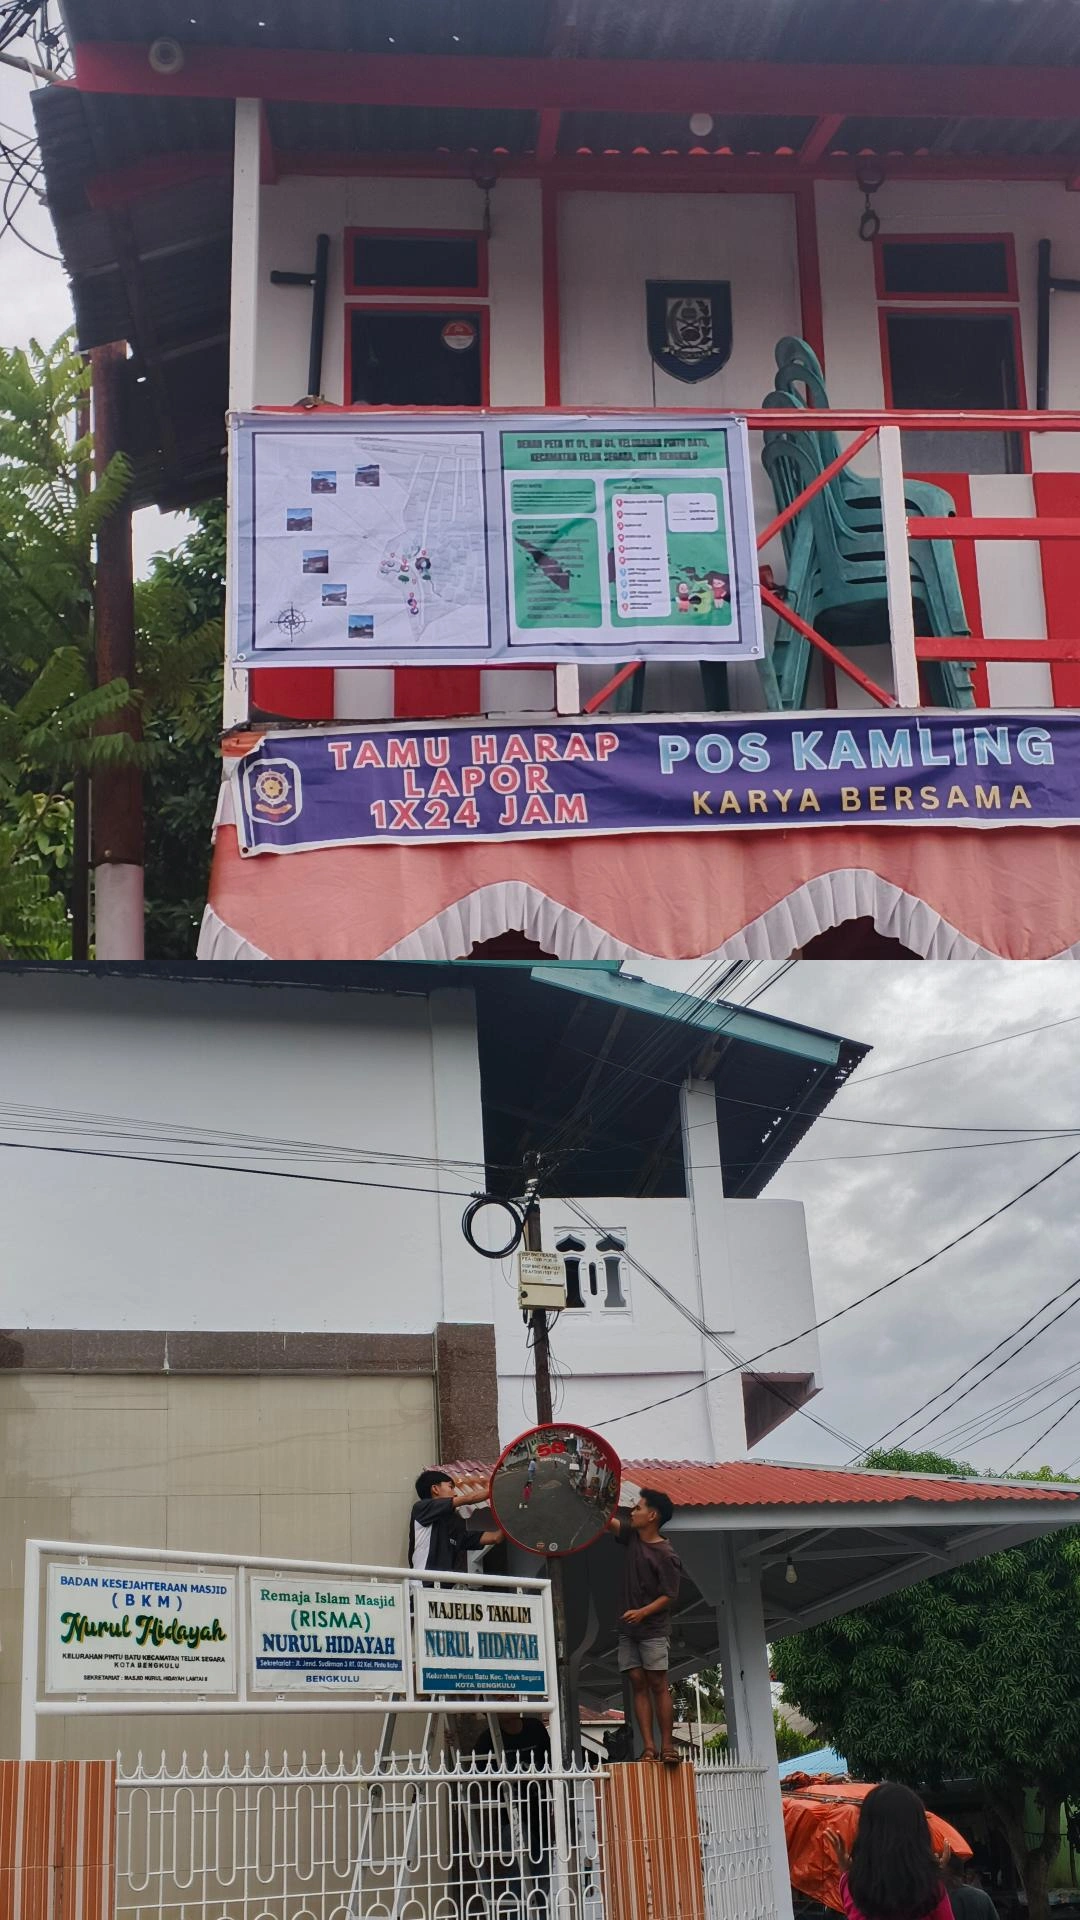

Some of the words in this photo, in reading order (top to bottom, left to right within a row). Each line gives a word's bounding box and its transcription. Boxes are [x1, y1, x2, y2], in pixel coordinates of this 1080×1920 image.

[328, 737, 451, 770] TAMU
[471, 731, 620, 765] HARAP
[658, 731, 772, 775] POS
[790, 726, 1055, 771] KAMLING
[404, 763, 554, 799] LAPOR
[370, 797, 480, 830] 1X24
[498, 793, 589, 826] JAM
[692, 787, 821, 815] KARYA
[840, 785, 1032, 813] BERSAMA
[60, 1575, 99, 1588] BADAN
[101, 1578, 188, 1593] KESEJAHTERAAN
[190, 1583, 227, 1595] MASJID
[260, 1589, 311, 1605] Remaja
[315, 1592, 351, 1605] Islam
[355, 1594, 396, 1609] Masjid
[290, 1609, 371, 1633] (RISMA)
[428, 1601, 484, 1621] MAJELIS
[487, 1605, 532, 1623] TAKLIM
[60, 1611, 132, 1644] Nurul
[135, 1614, 227, 1649] Hidayah
[262, 1633, 323, 1653] NURUL
[325, 1635, 396, 1655] HIDAYAH
[424, 1628, 475, 1658] NURUL
[477, 1631, 539, 1660] HIDAYAH
[306, 1675, 360, 1683] BENGKULU
